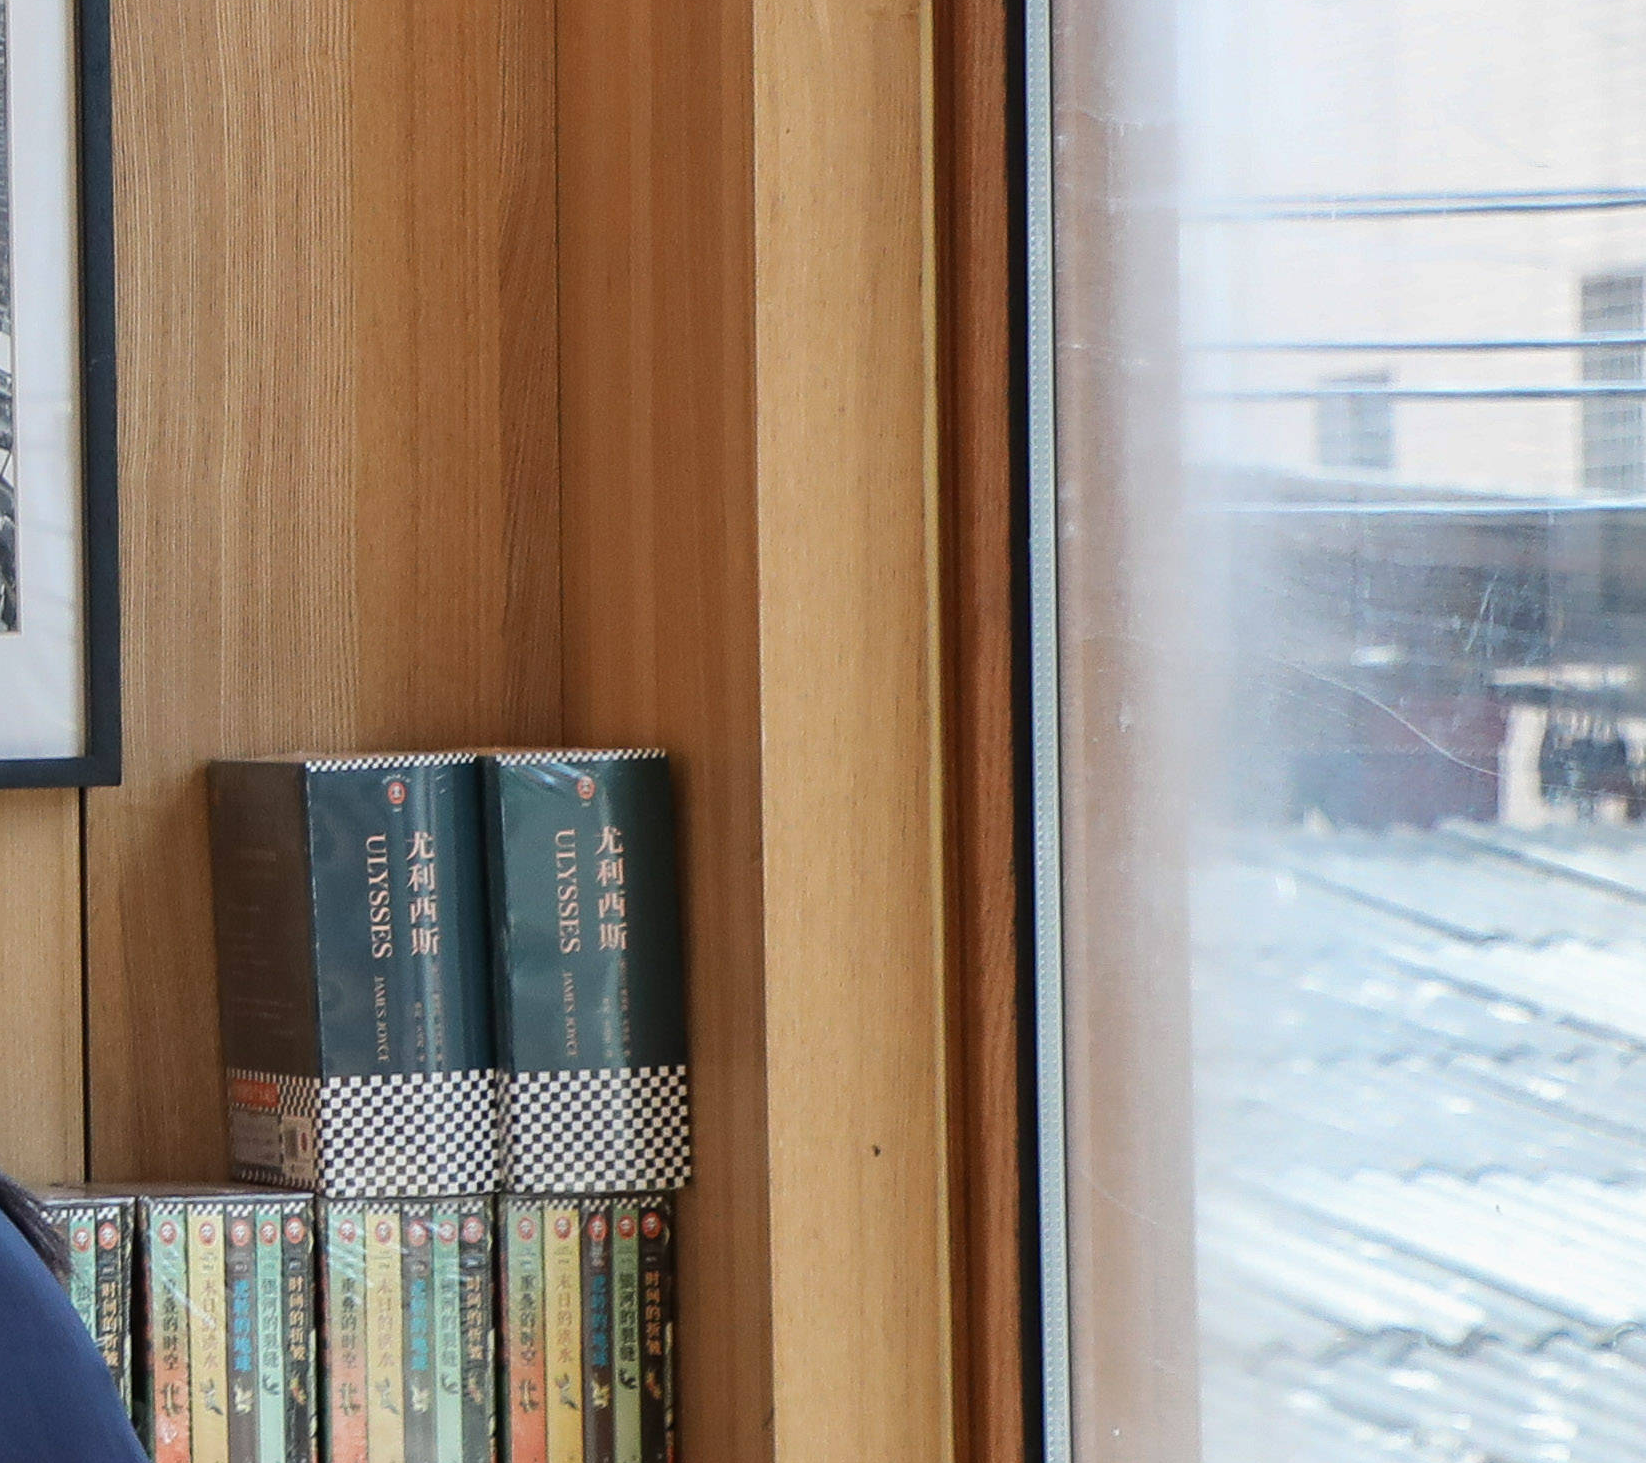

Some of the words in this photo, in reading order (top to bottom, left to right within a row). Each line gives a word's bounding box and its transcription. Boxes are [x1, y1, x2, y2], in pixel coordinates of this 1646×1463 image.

[366, 832, 393, 960] ULYSSES
[405, 830, 441, 957] 尤利西斯
[554, 828, 581, 955] ULYSSES
[595, 825, 628, 953] 尤利西斯
